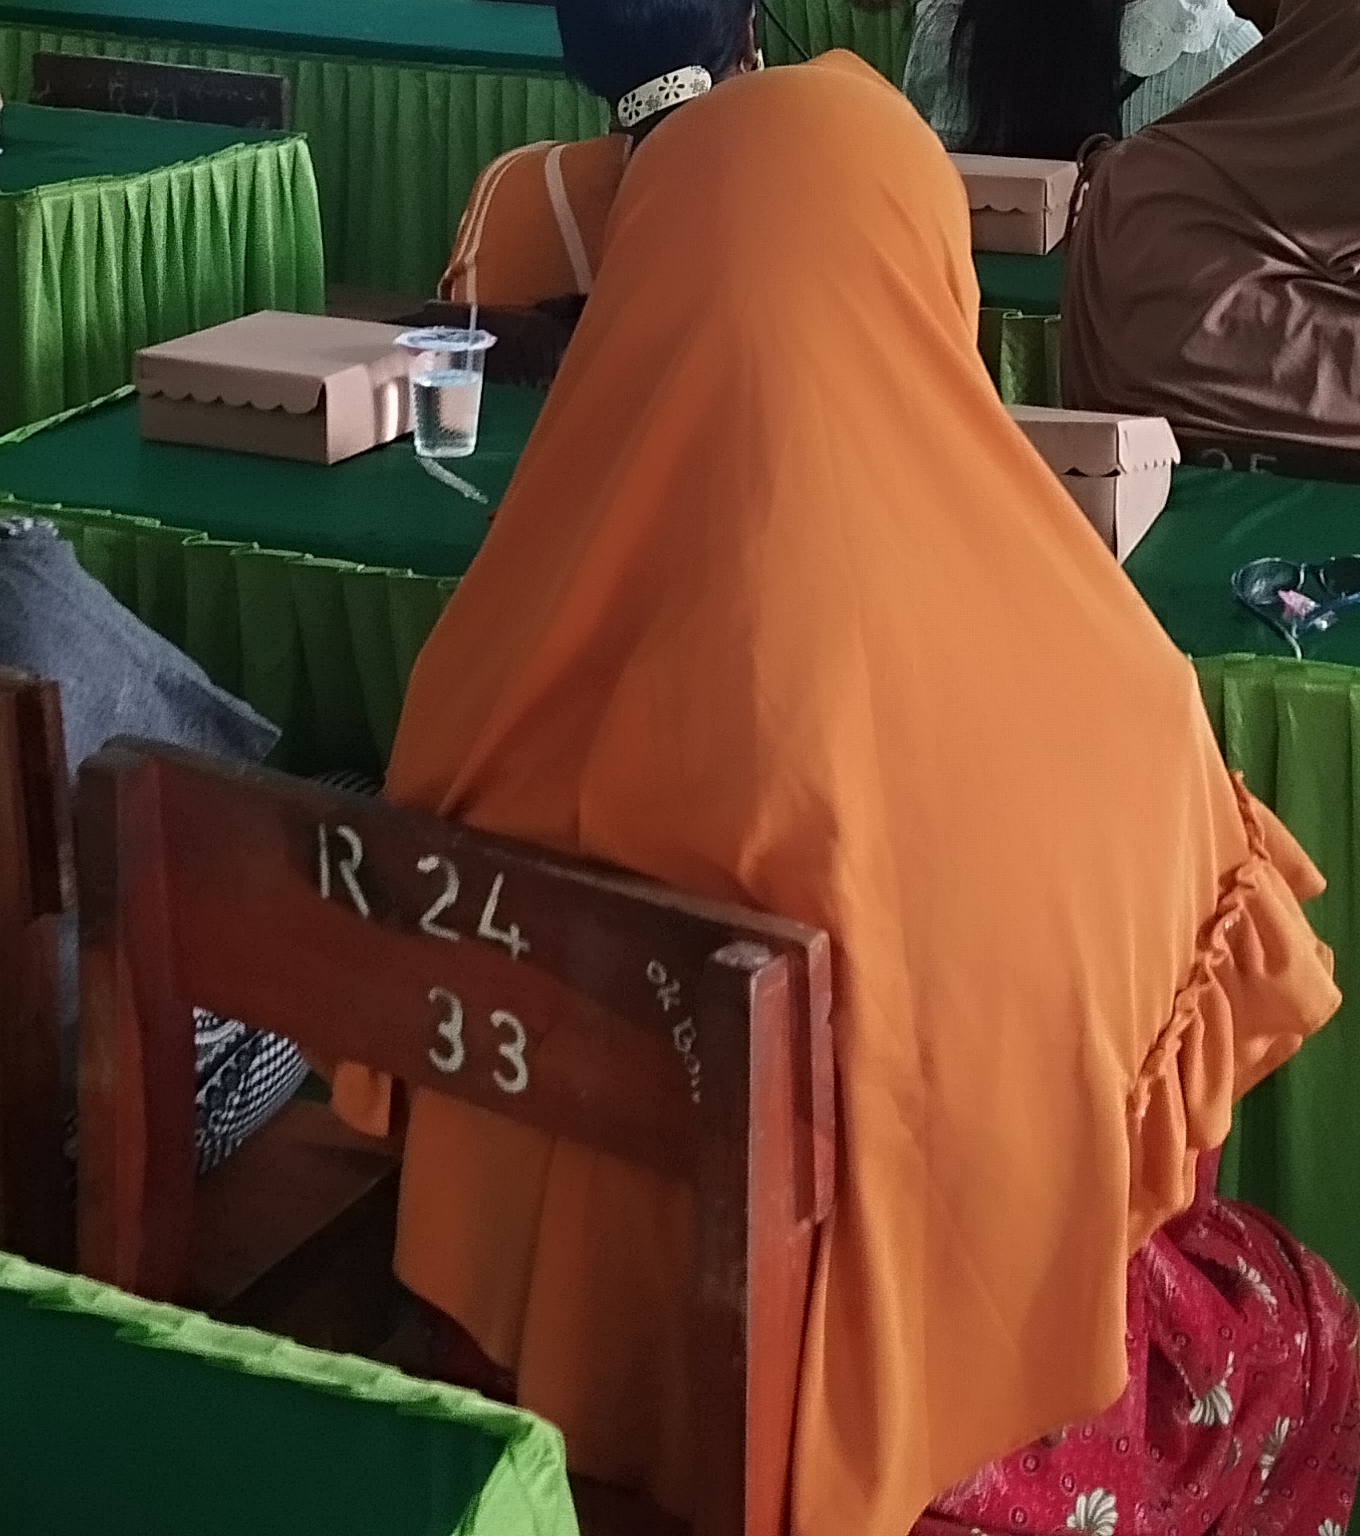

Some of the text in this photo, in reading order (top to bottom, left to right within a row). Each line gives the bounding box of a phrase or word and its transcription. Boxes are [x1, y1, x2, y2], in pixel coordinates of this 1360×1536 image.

[318, 821, 531, 959] R 24
[427, 987, 530, 1094] 33
